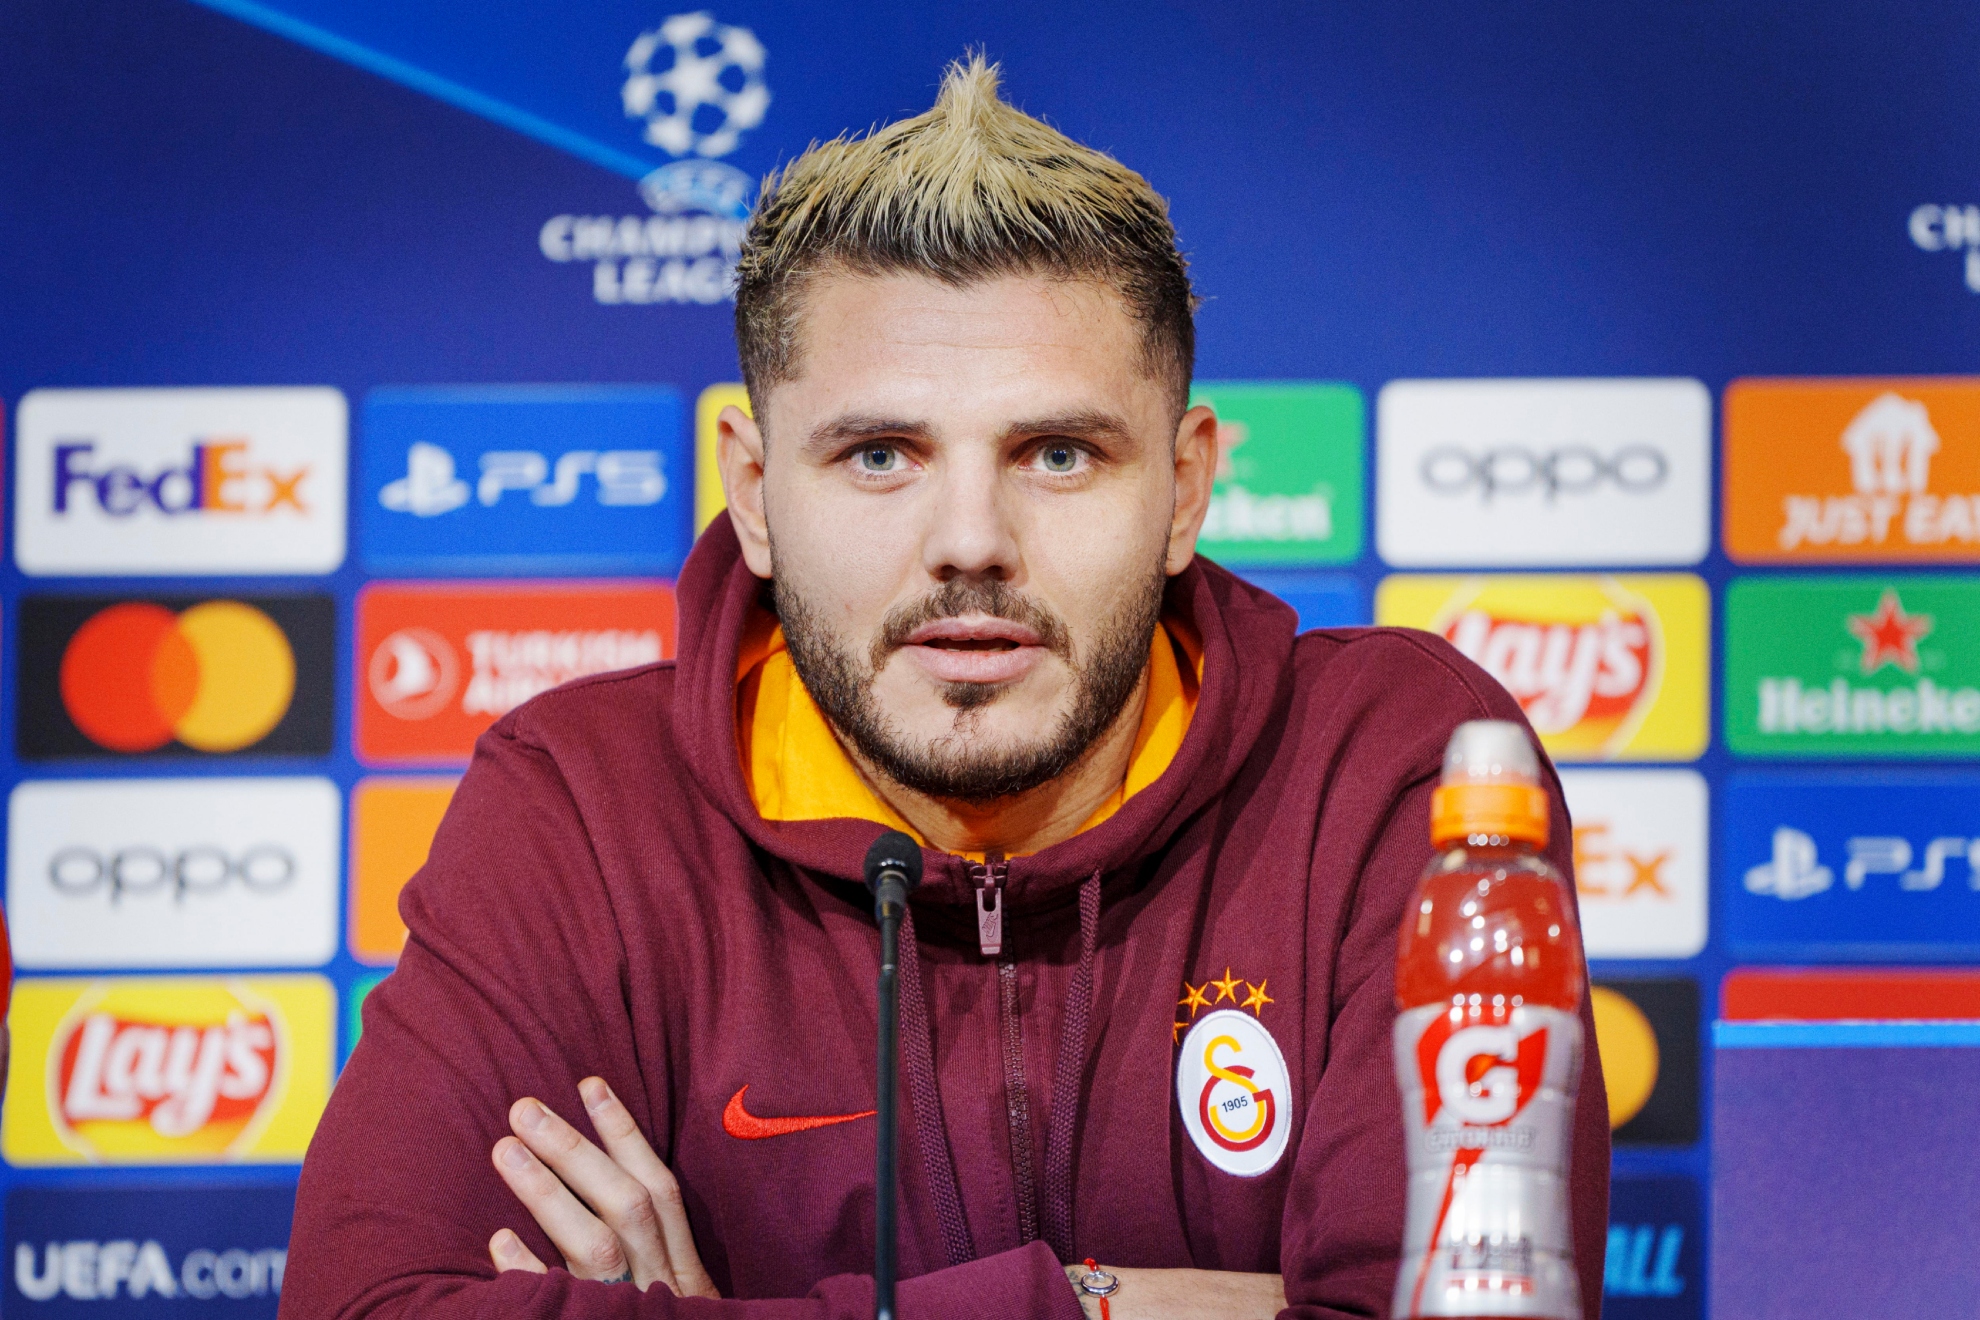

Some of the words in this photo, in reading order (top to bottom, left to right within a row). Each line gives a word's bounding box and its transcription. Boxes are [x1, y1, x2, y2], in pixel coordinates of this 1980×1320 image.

[539, 214, 747, 262] CHAMPI
[593, 257, 739, 304] LEAG
[52, 439, 311, 516] FedEx
[478, 450, 666, 507] PS5
[1419, 446, 1669, 508] oppo
[1779, 495, 1901, 550] JUST
[1904, 494, 1980, 544] EA
[1758, 676, 1980, 735] Heineke
[49, 845, 296, 909] oppo
[1846, 836, 1980, 891] PS
[63, 1010, 270, 1137] Lay's
[1221, 1096, 1248, 1113] 1905
